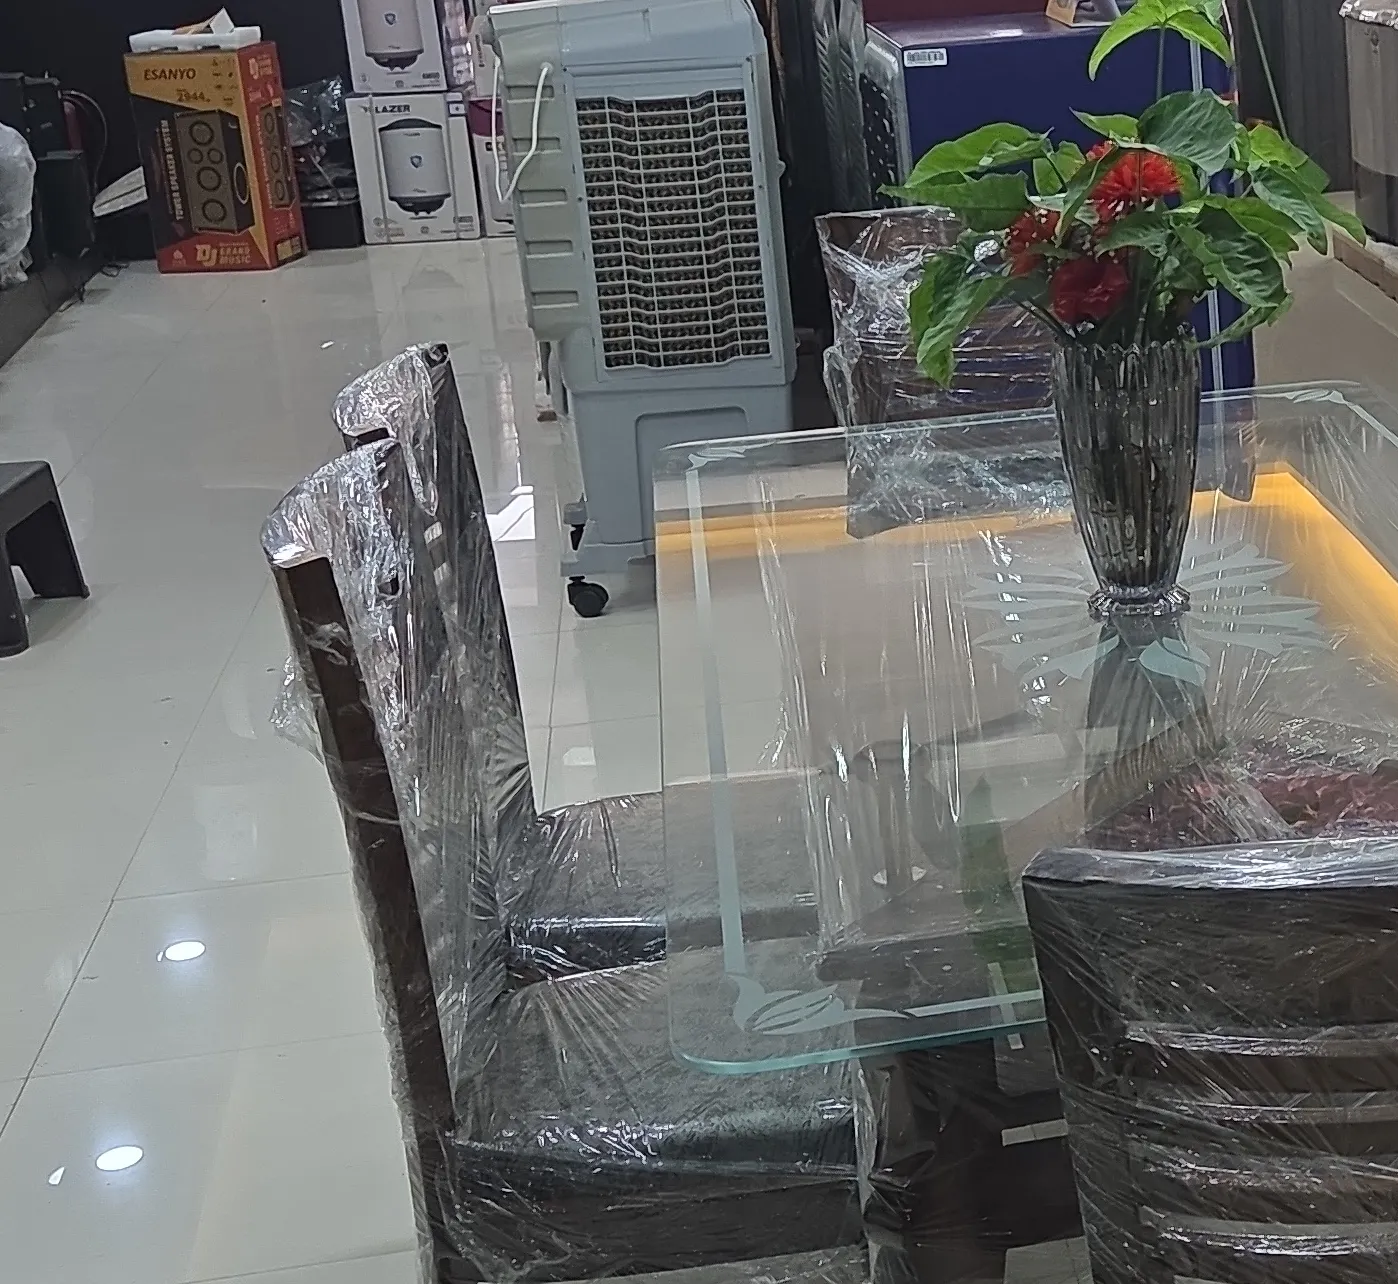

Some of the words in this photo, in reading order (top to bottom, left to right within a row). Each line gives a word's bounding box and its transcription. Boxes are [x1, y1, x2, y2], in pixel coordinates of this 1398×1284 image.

[143, 67, 197, 81] ESANYO
[374, 104, 411, 114] LAZER
[195, 244, 218, 267] DJ
[219, 254, 252, 265] MUSIC
